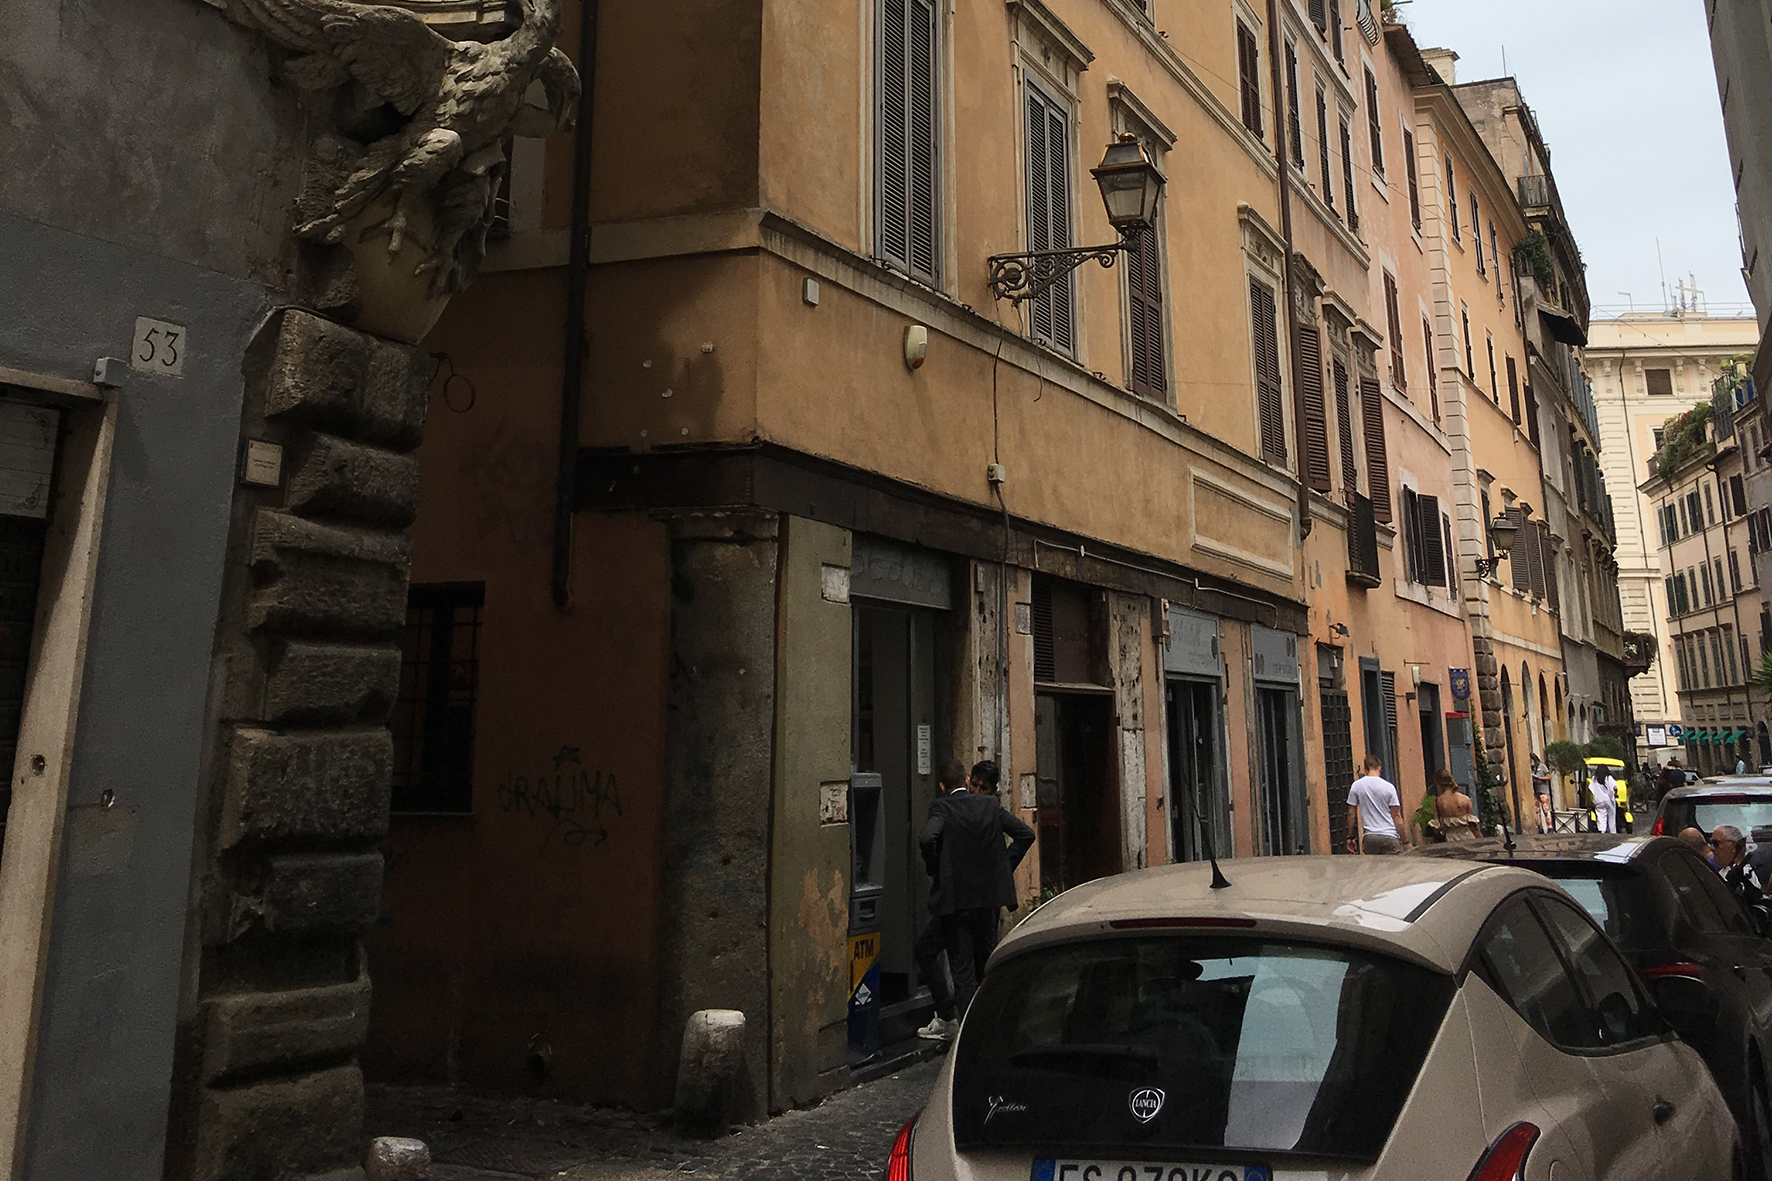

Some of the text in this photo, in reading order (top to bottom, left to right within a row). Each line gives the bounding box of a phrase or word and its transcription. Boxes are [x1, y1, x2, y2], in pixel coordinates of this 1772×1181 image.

[139, 328, 180, 367] 53
[853, 938, 875, 960] ATM
[1135, 1099, 1157, 1109] LANCIA
